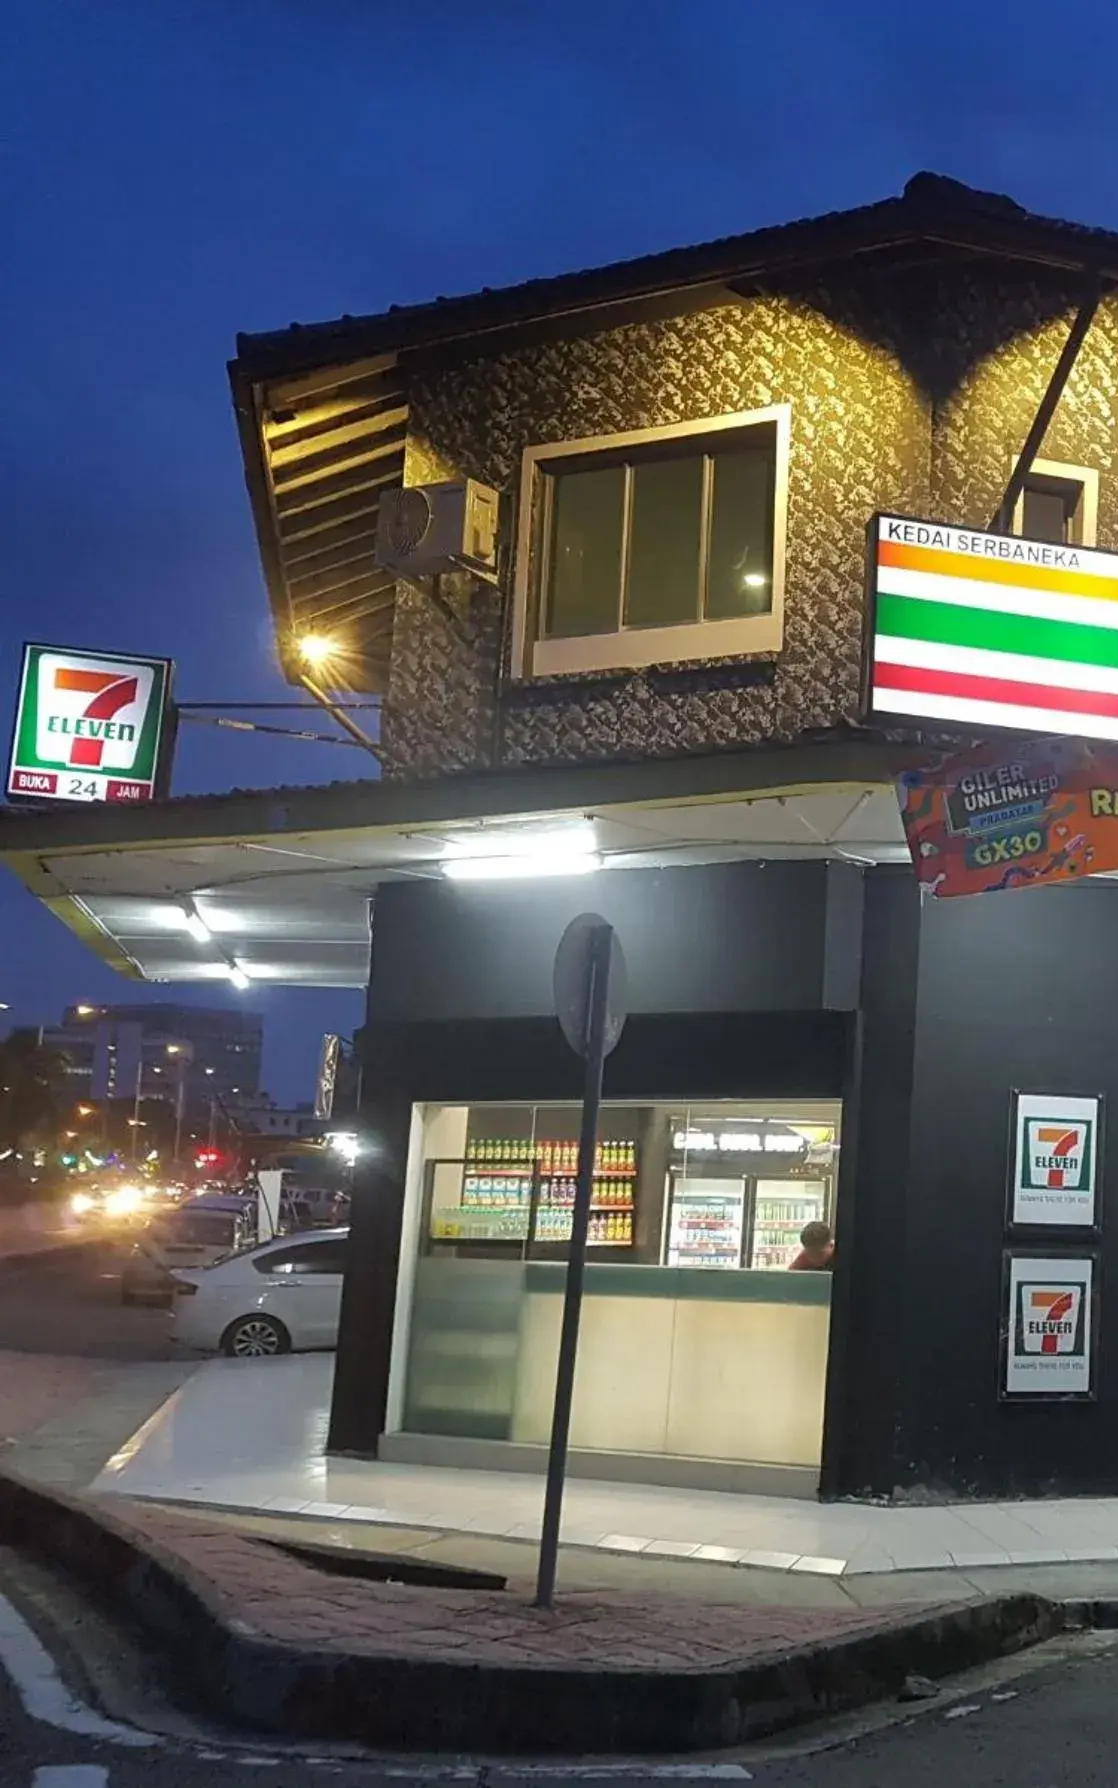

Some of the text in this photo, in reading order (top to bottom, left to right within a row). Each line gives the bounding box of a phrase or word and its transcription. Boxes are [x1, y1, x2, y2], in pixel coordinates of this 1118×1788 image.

[887, 521, 1081, 568] KEDAI SERBANEKA
[18, 774, 141, 800] BUKA 24 JAM
[974, 830, 1042, 866] GX30
